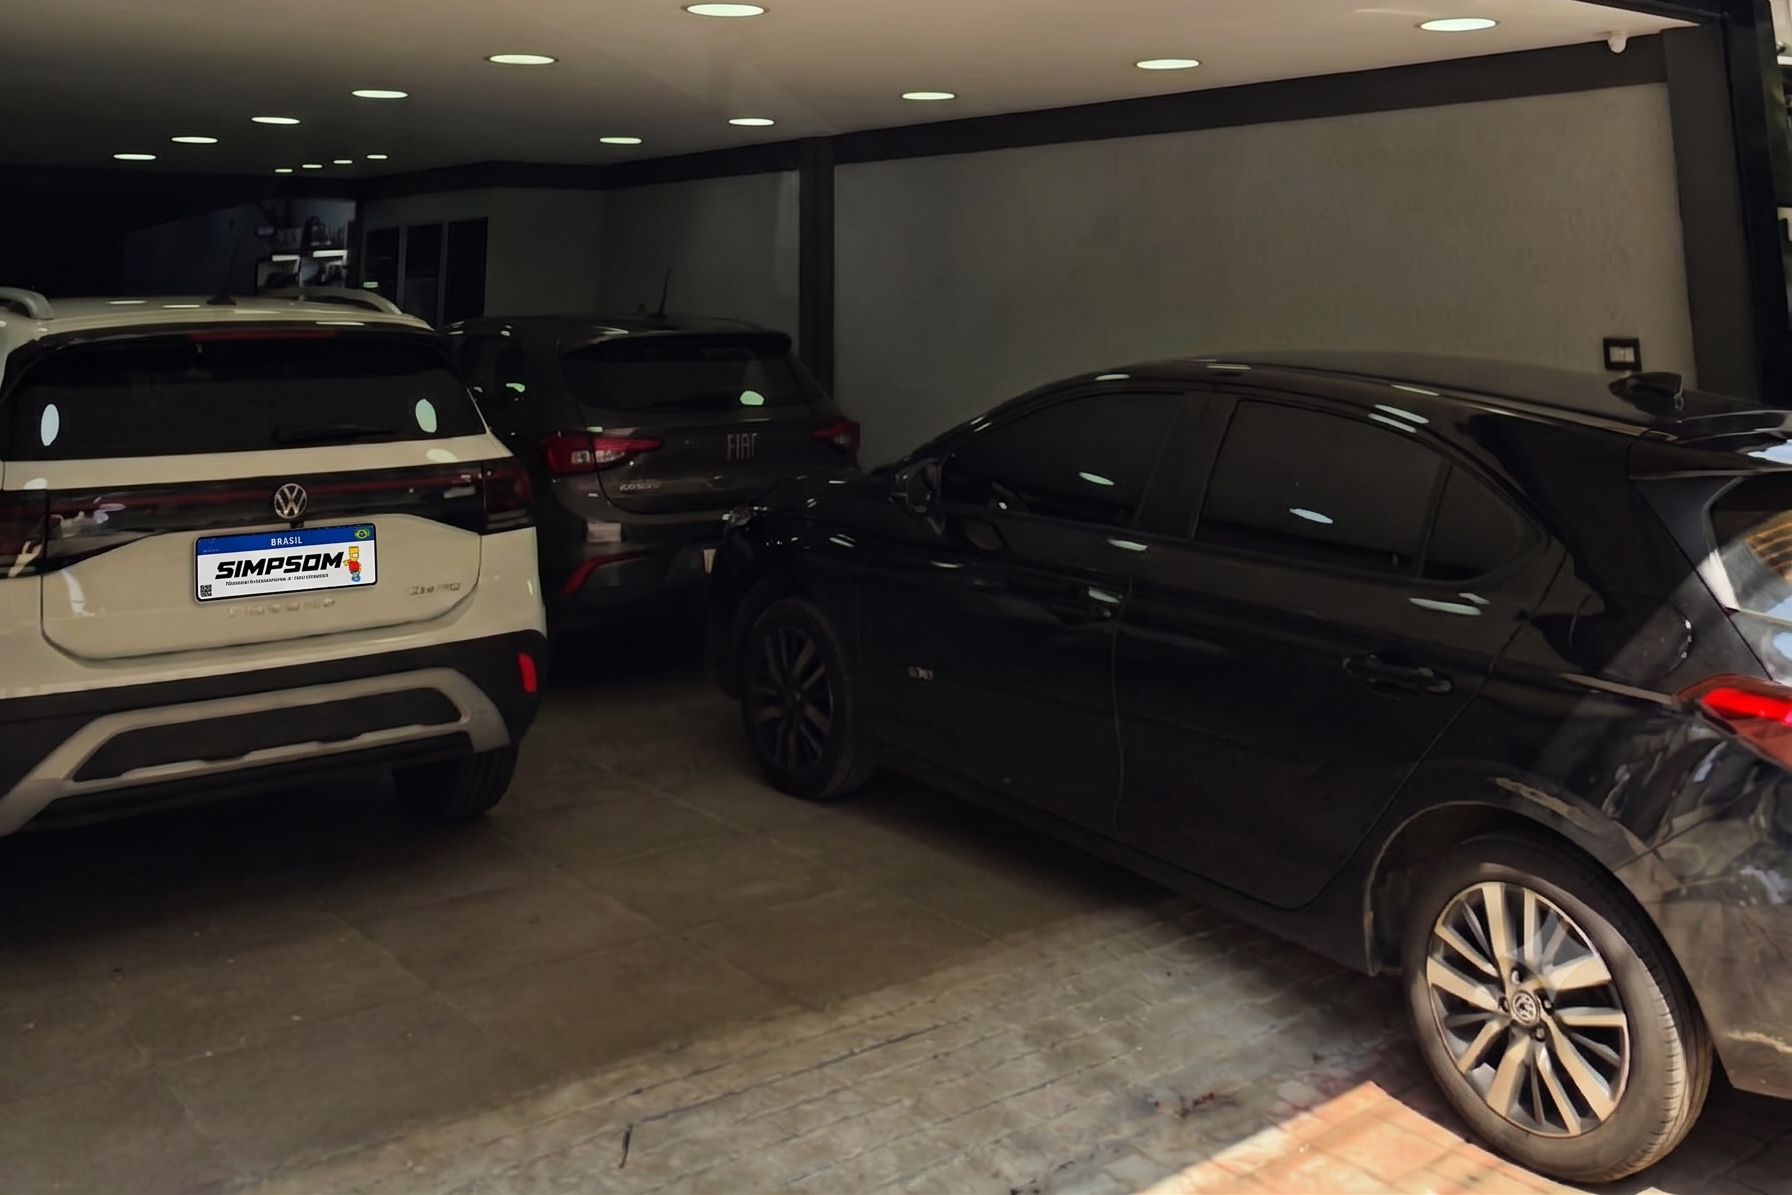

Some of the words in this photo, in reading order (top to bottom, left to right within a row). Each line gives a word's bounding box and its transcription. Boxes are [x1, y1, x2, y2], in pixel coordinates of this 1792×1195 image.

[727, 433, 758, 460] FIAT
[270, 536, 303, 547] BRASIL
[215, 551, 345, 580] SIMPSOM
